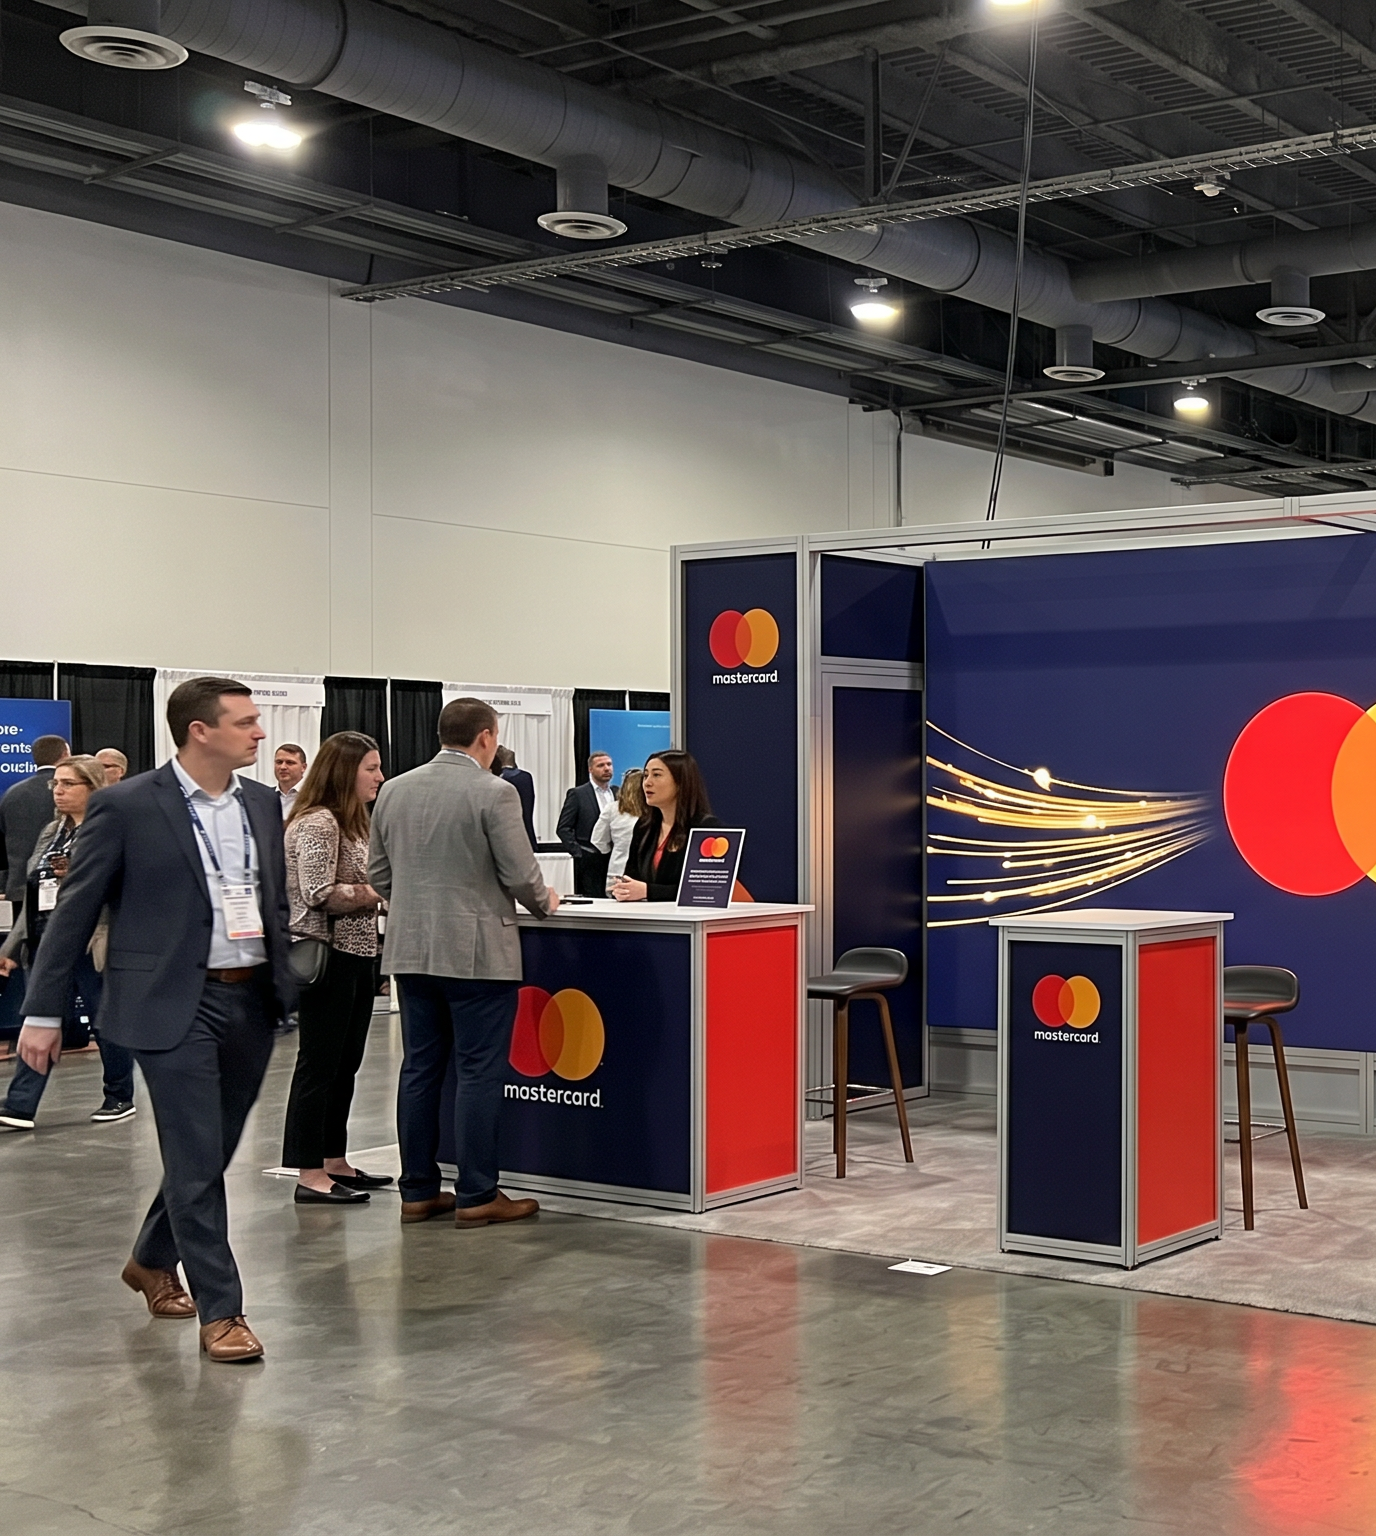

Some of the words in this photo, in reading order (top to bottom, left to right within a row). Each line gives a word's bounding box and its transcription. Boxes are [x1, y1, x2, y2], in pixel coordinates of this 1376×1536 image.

[712, 669, 778, 684] mastercard
[0, 742, 32, 754] ents
[1034, 1030, 1099, 1043] mastercard
[504, 1084, 601, 1108] mastercard
